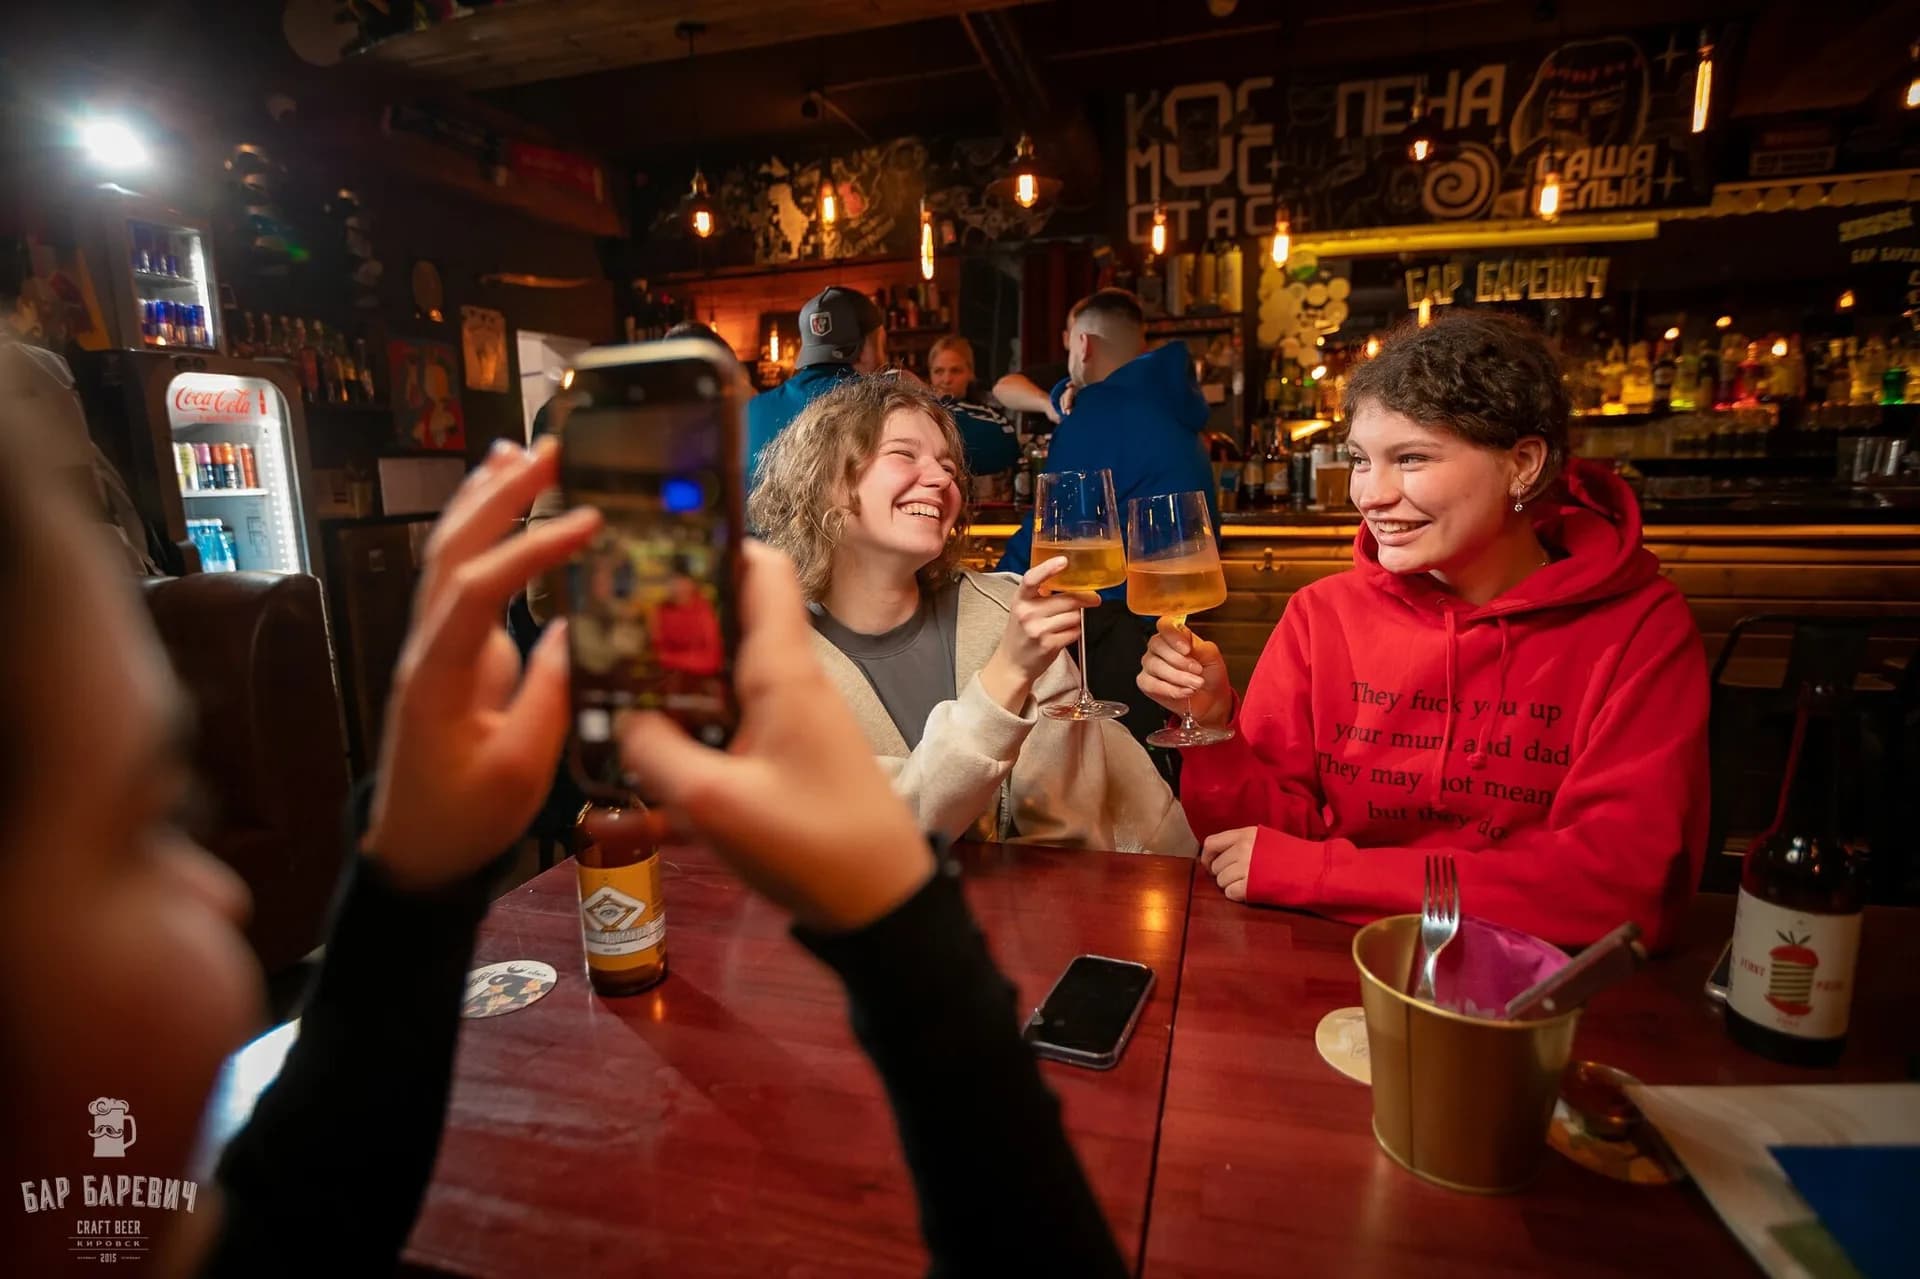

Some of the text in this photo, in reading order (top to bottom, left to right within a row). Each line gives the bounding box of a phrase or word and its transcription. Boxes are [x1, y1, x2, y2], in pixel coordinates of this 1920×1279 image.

[1335, 64, 1506, 139] ПЕНА
[1127, 195, 1274, 245] СТАС
[1405, 255, 1611, 309] БАР БАРЕВИЧ
[1352, 681, 1562, 727] They fuck yu up
[1333, 723, 1383, 744] your
[1523, 741, 1570, 767] dad
[1316, 751, 1361, 784] They
[1370, 767, 1423, 794] may
[1484, 780, 1554, 807] mean
[1367, 801, 1408, 821] but
[1477, 817, 1510, 841] do
